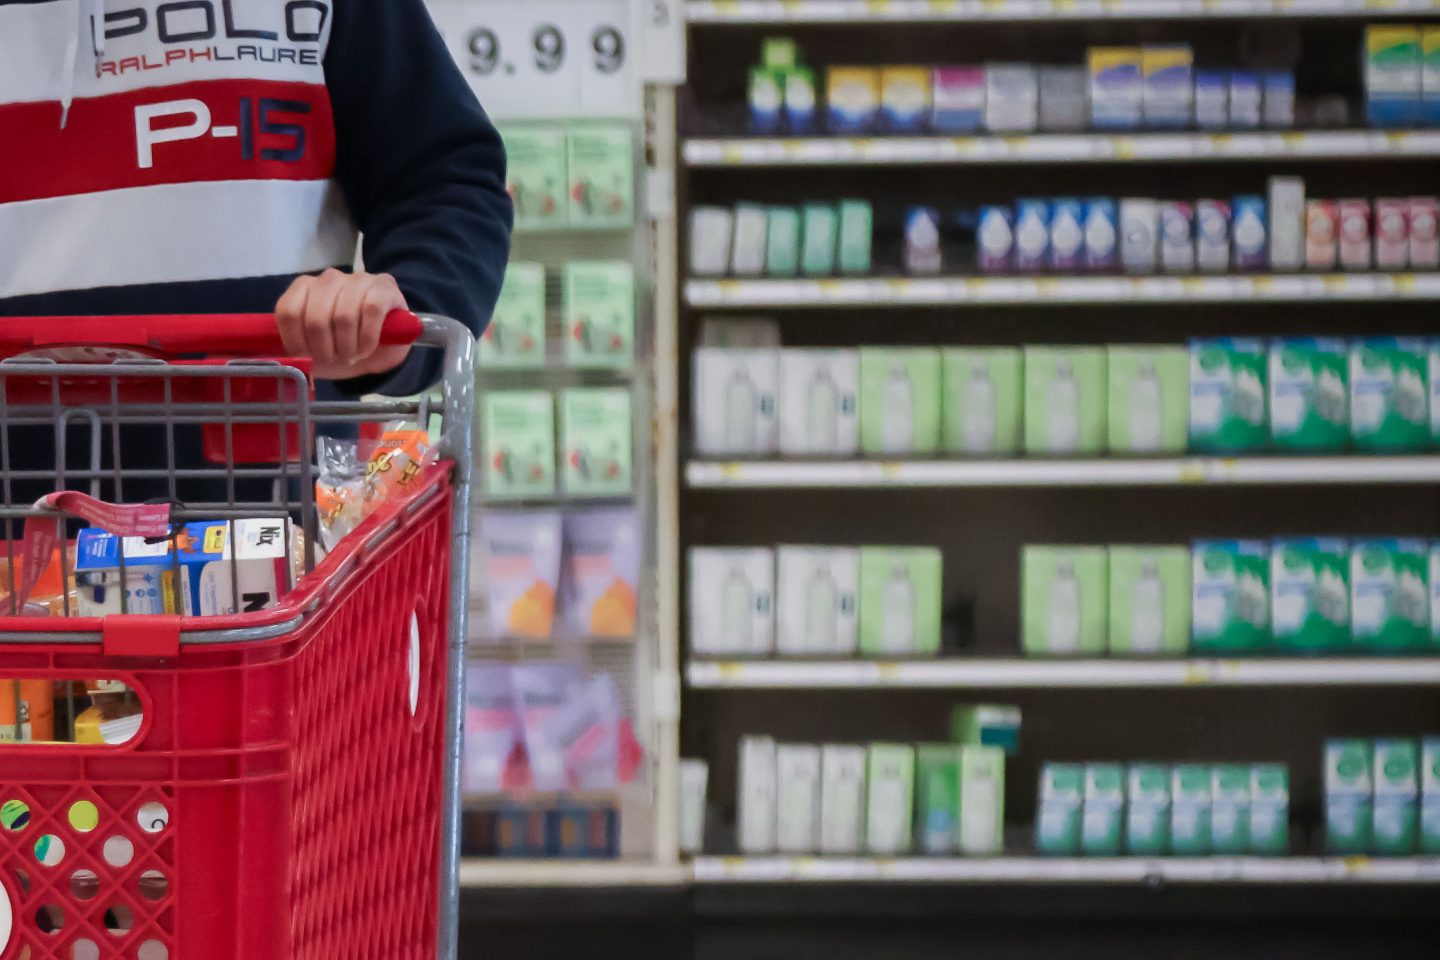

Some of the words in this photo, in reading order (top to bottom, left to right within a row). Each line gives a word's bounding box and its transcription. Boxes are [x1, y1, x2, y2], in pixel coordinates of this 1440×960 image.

[90, 0, 329, 56] POLO
[467, 24, 626, 76] 9.99
[96, 45, 319, 79] RALPHLAURE
[134, 97, 310, 169] P-15
